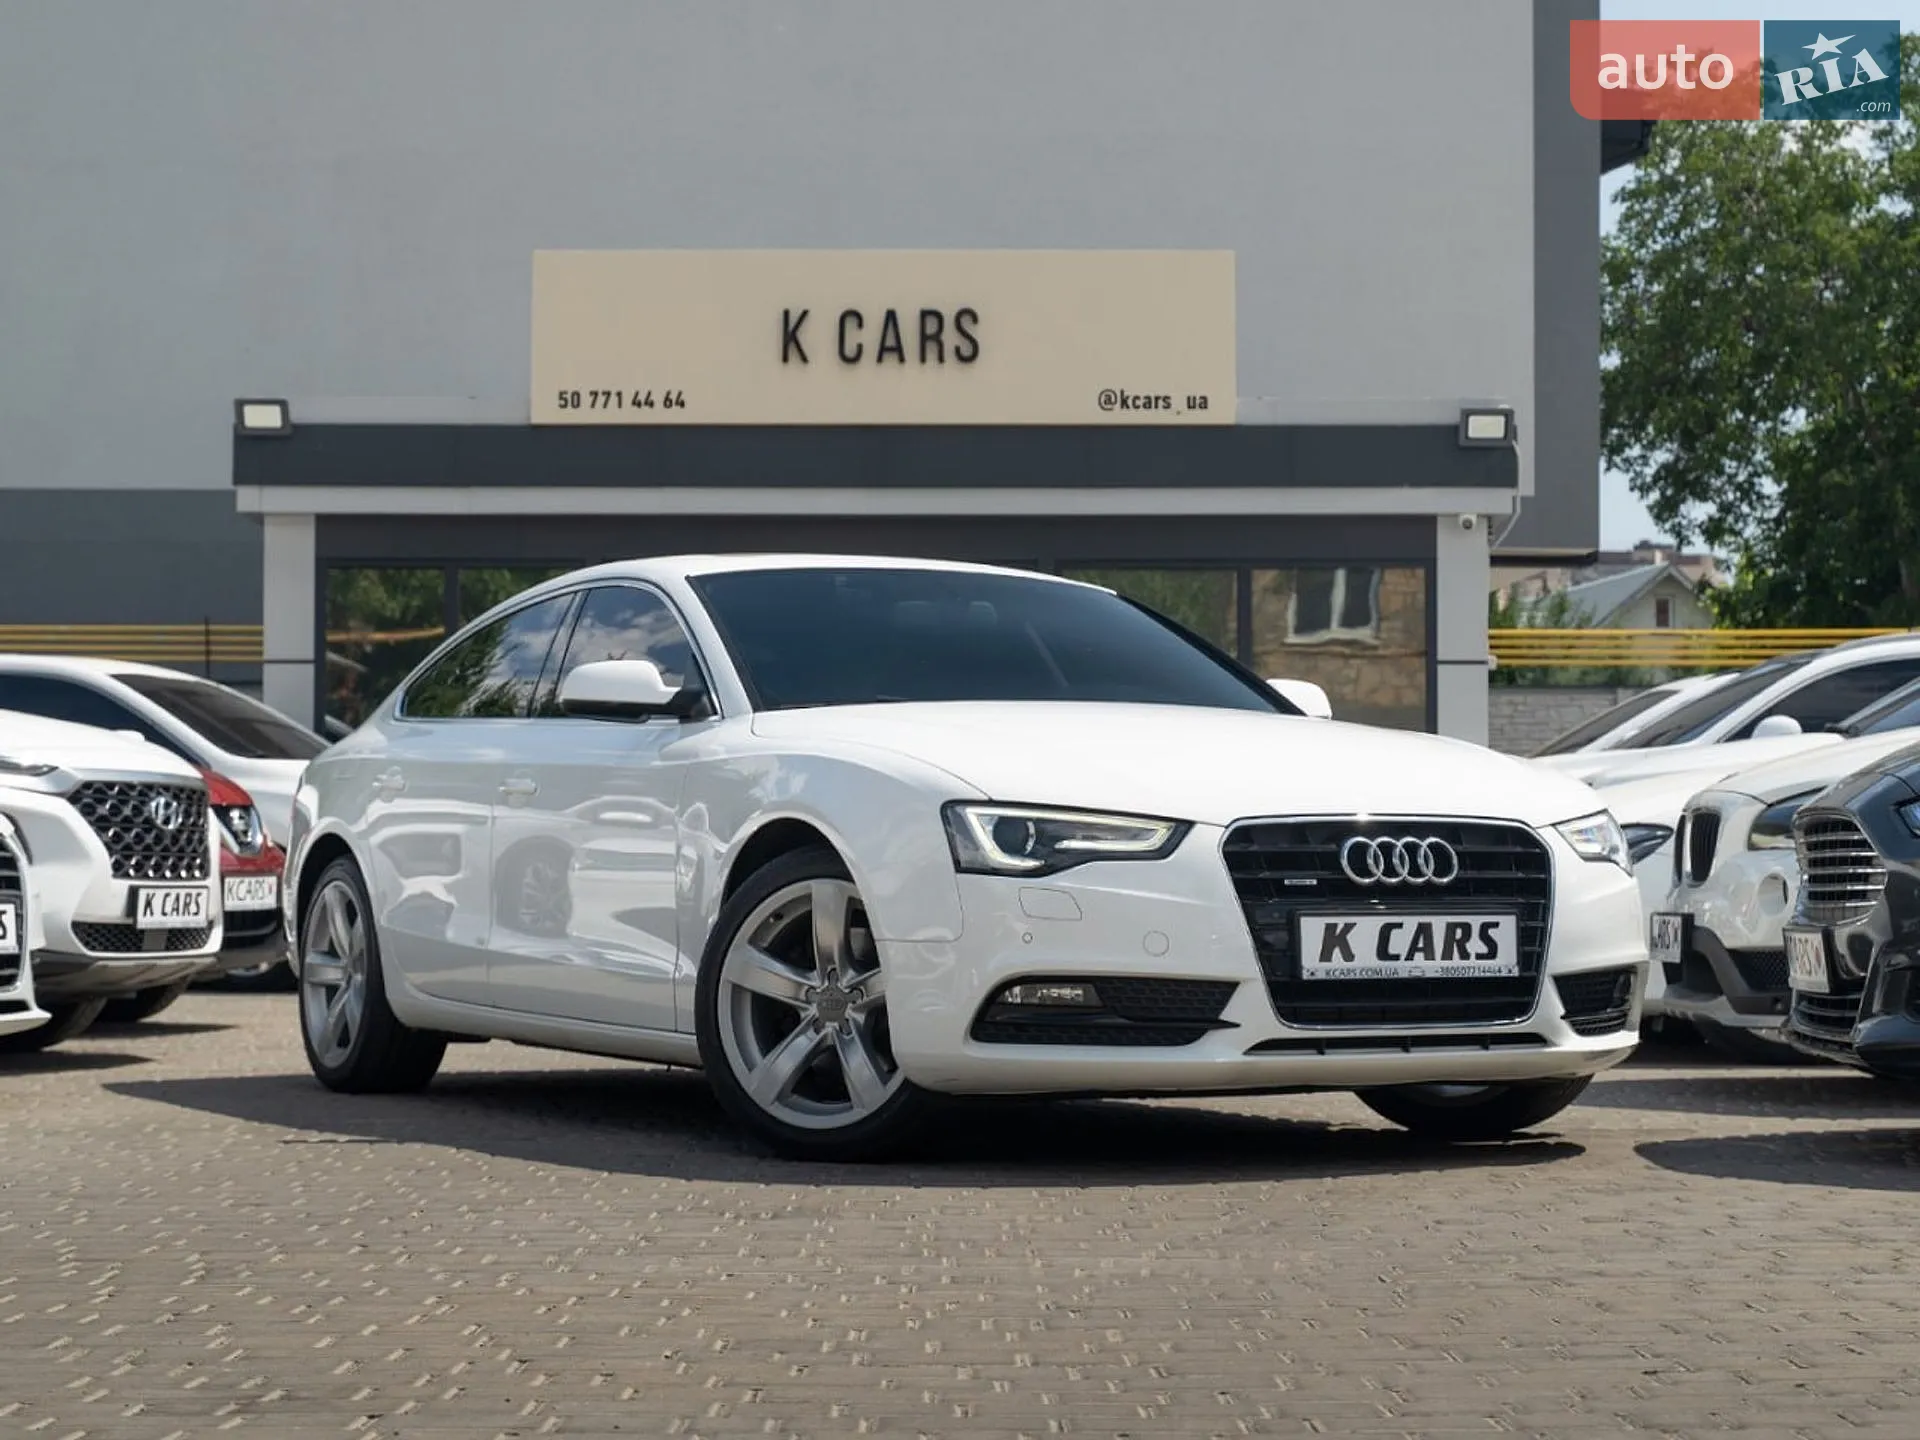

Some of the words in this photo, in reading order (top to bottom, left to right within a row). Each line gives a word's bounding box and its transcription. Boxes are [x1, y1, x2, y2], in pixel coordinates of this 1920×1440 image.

[782, 308, 810, 364] K
[837, 307, 980, 365] CARS
[558, 390, 581, 409] 50
[589, 390, 623, 409] 771
[631, 390, 655, 409] 44
[662, 389, 686, 409] 64
[143, 892, 156, 917] K
[161, 892, 202, 917] CARS
[1319, 922, 1357, 963] K
[1376, 921, 1501, 962] CARS
